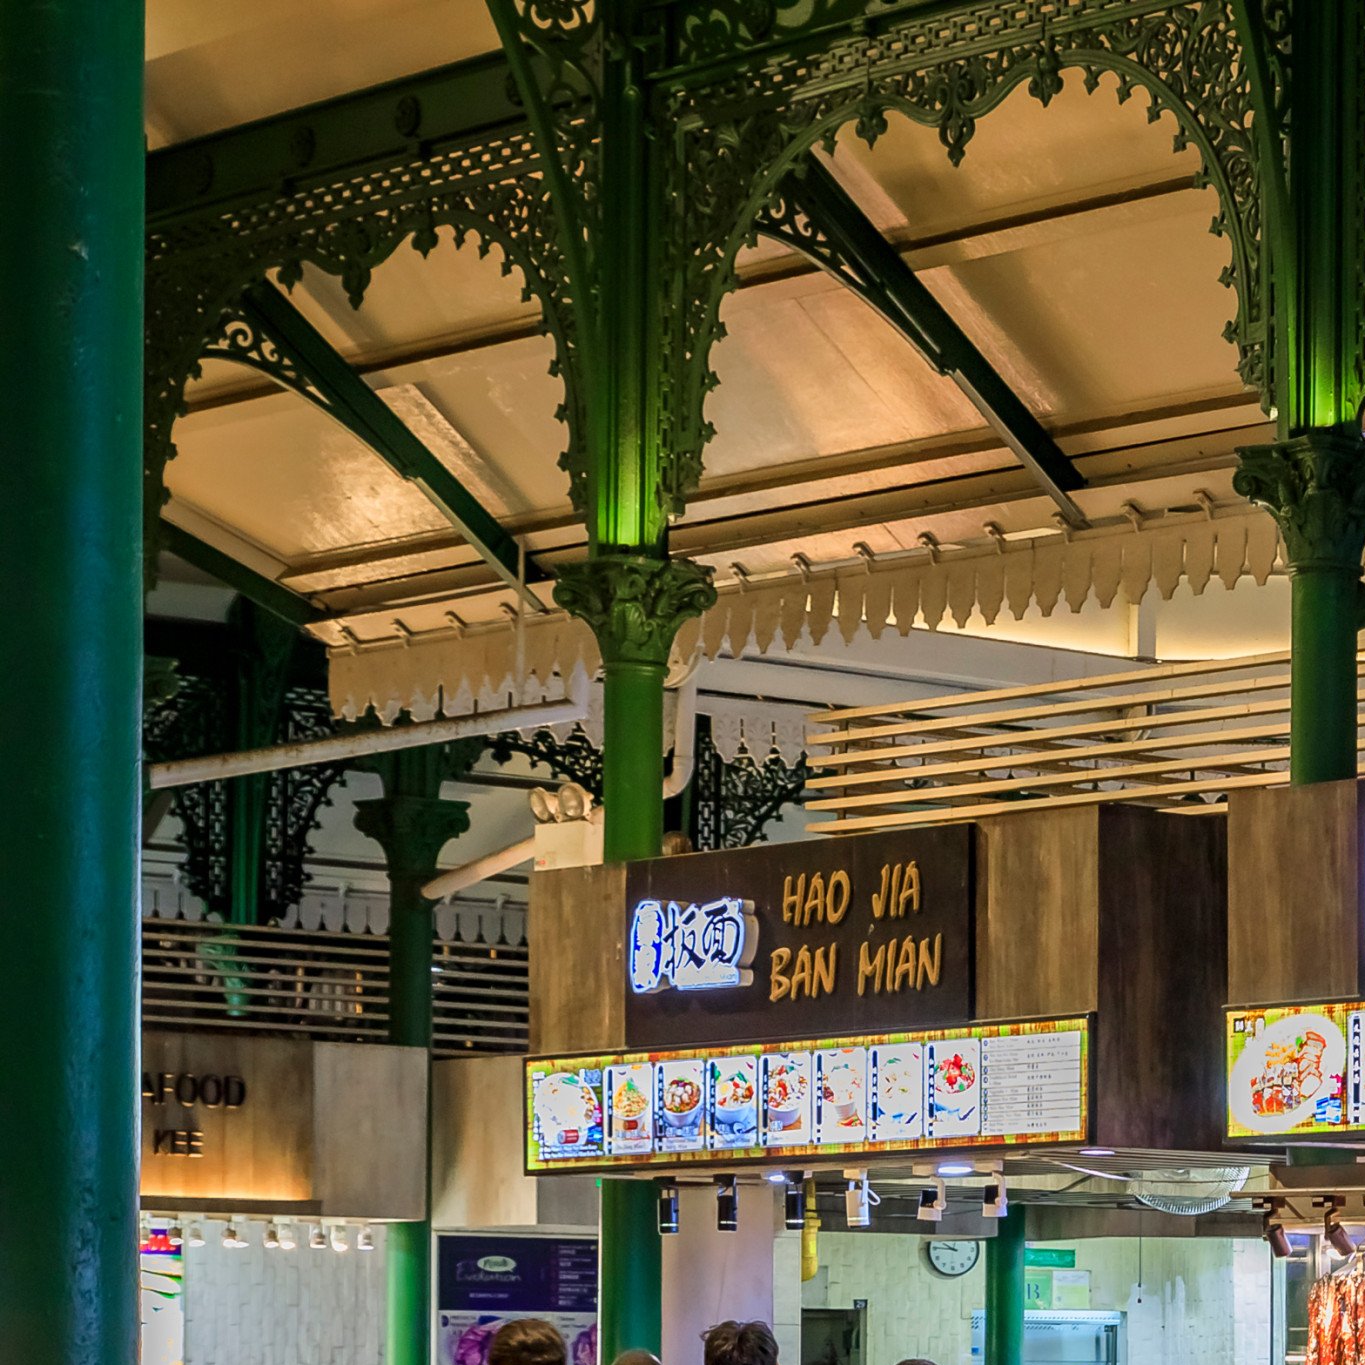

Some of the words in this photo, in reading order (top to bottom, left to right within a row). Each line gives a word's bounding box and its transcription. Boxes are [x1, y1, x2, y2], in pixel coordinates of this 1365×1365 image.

[783, 870, 850, 926] HAO
[872, 861, 920, 919] JIA
[769, 942, 837, 1002] BAN
[857, 933, 942, 996] MIAN
[153, 1129, 204, 1158] KEE
